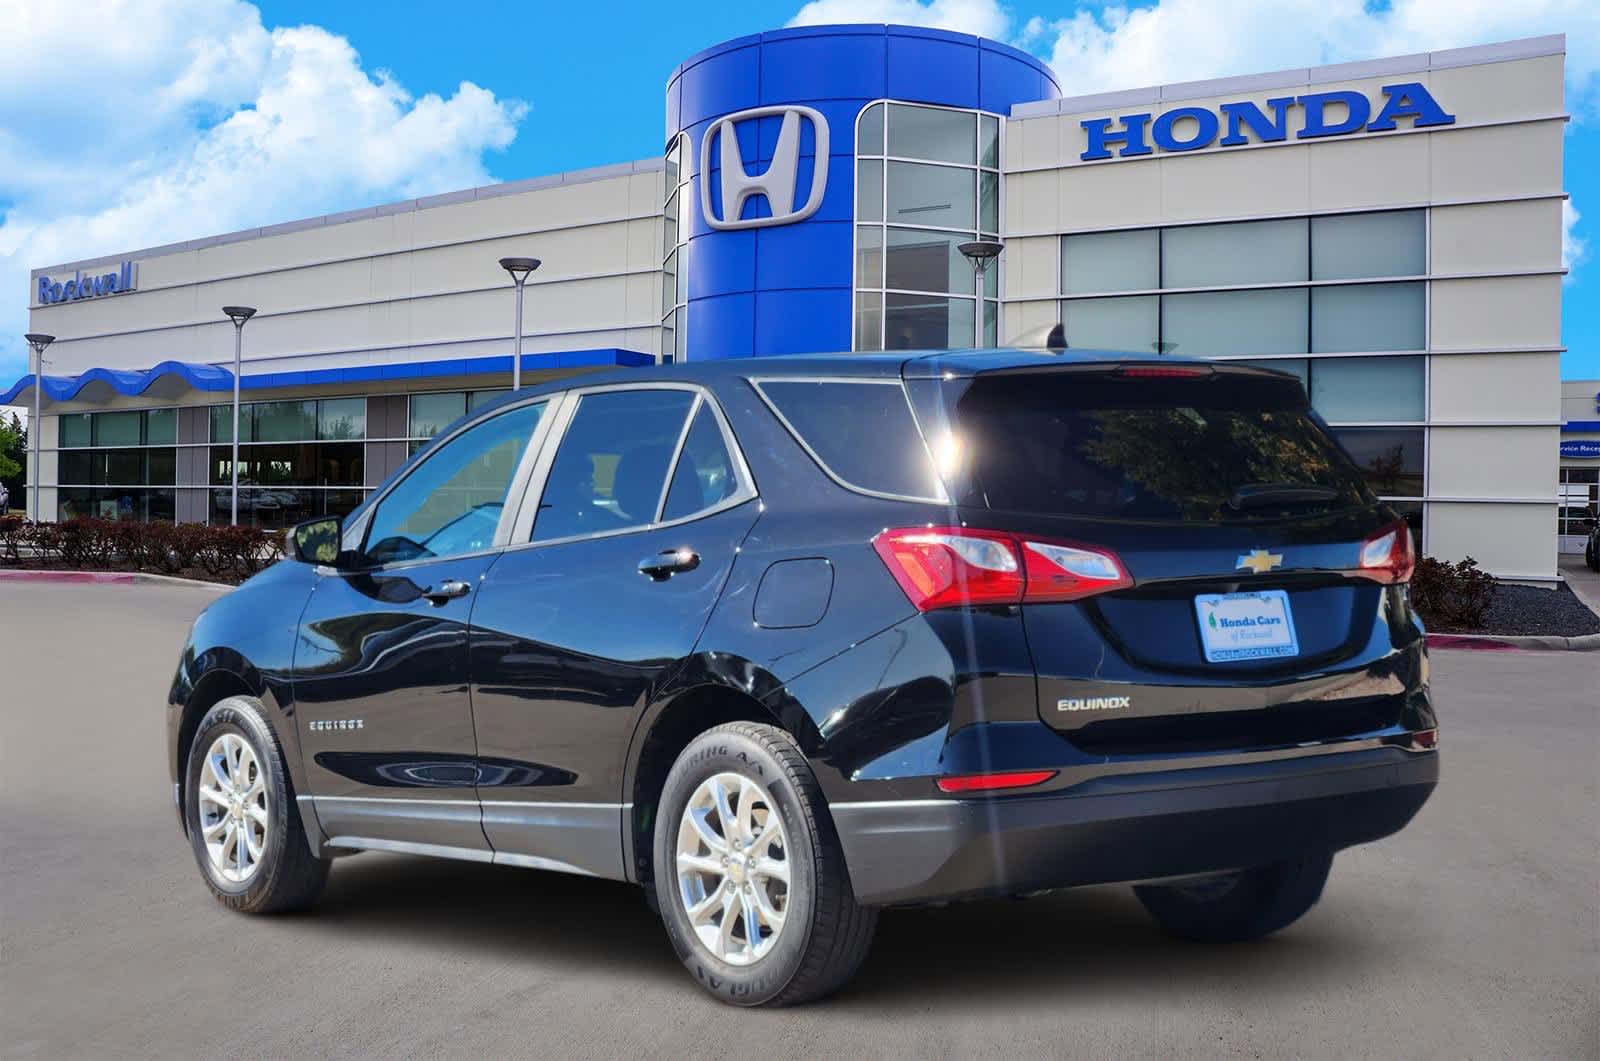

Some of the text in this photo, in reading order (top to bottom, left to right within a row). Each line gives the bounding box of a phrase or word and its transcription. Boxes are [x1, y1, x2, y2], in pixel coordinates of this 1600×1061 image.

[1080, 82, 1456, 161] HONDA
[38, 261, 132, 304] Rockwall
[1220, 615, 1281, 627] Honda Cars
[1057, 696, 1130, 711] EQUINOX
[309, 719, 364, 731] EQUINOX
